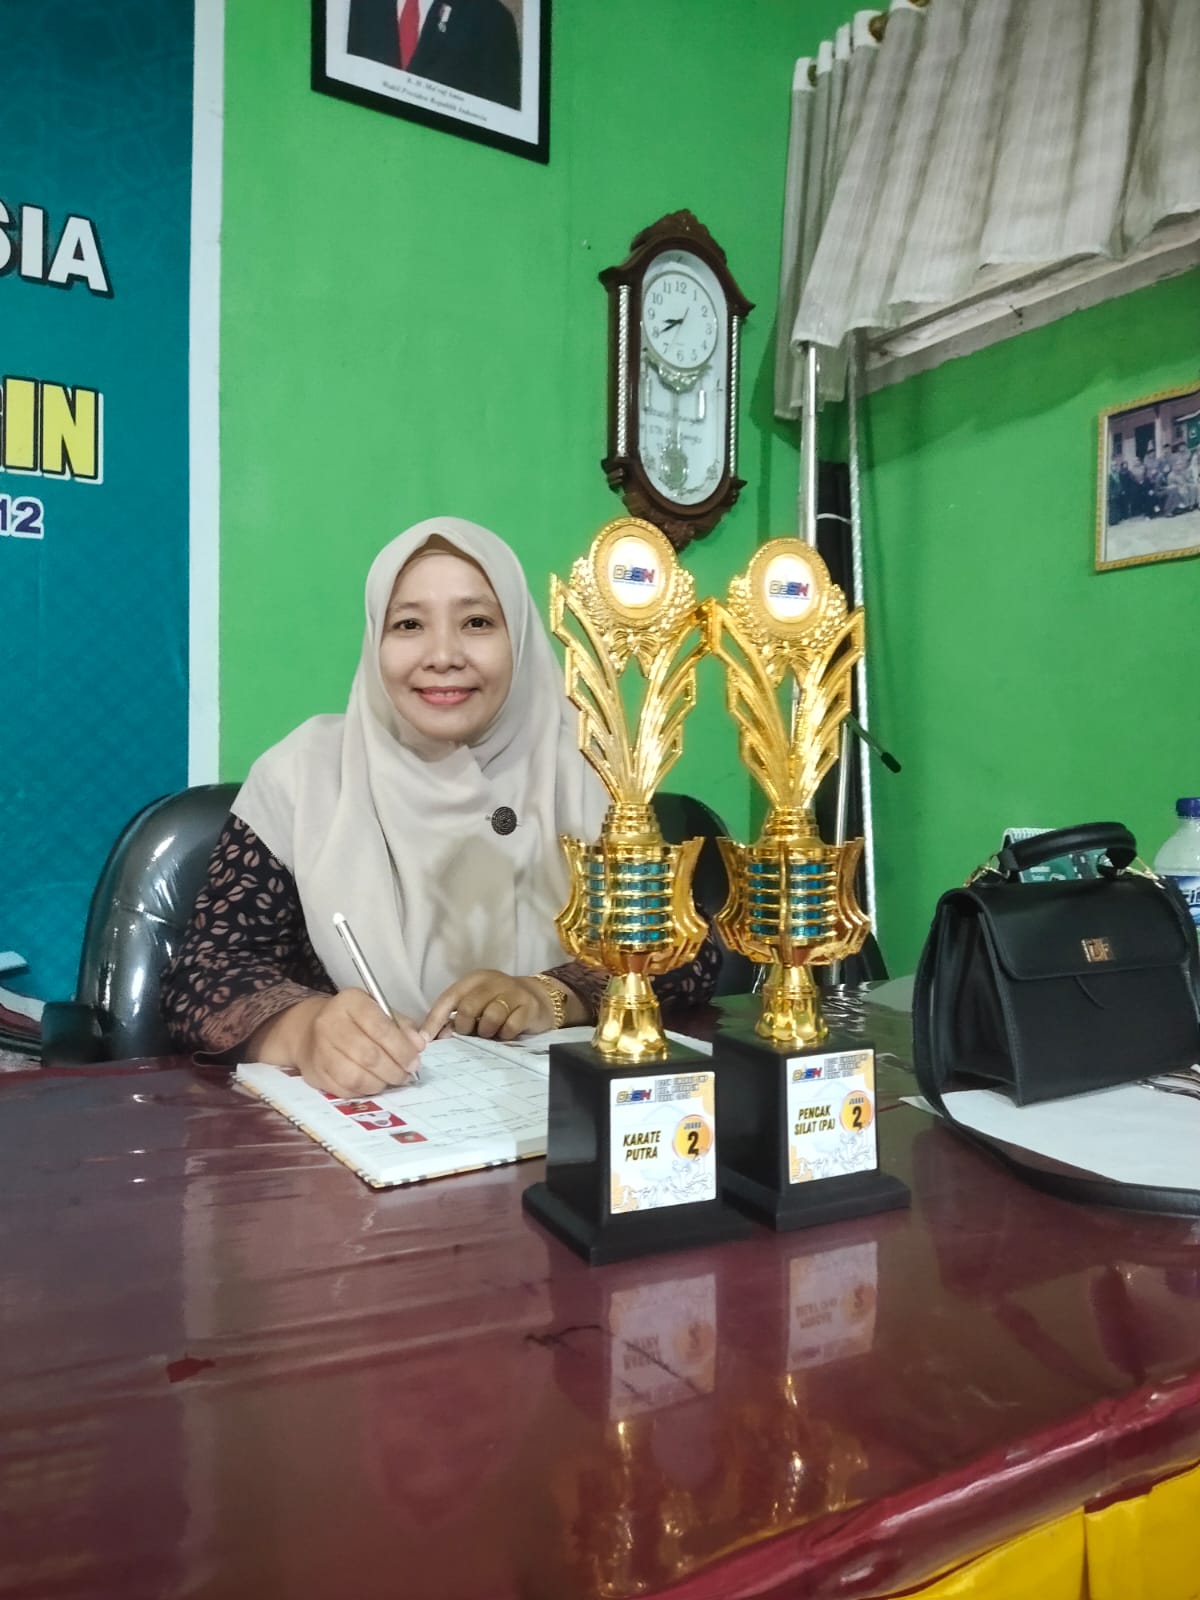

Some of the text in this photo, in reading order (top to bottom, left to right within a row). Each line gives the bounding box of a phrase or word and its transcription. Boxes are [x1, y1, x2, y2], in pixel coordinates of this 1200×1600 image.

[663, 281, 671, 294] 11
[675, 280, 687, 295] 12
[652, 291, 663, 306] 10
[647, 307, 655, 320] 9
[701, 304, 708, 318] 2
[798, 1104, 832, 1121] PENCAK
[852, 1105, 862, 1128] 2
[794, 1120, 817, 1136] SILAT
[623, 1130, 661, 1148] KARATE
[687, 1131, 700, 1156] 2
[625, 1146, 658, 1162] PUTRA
